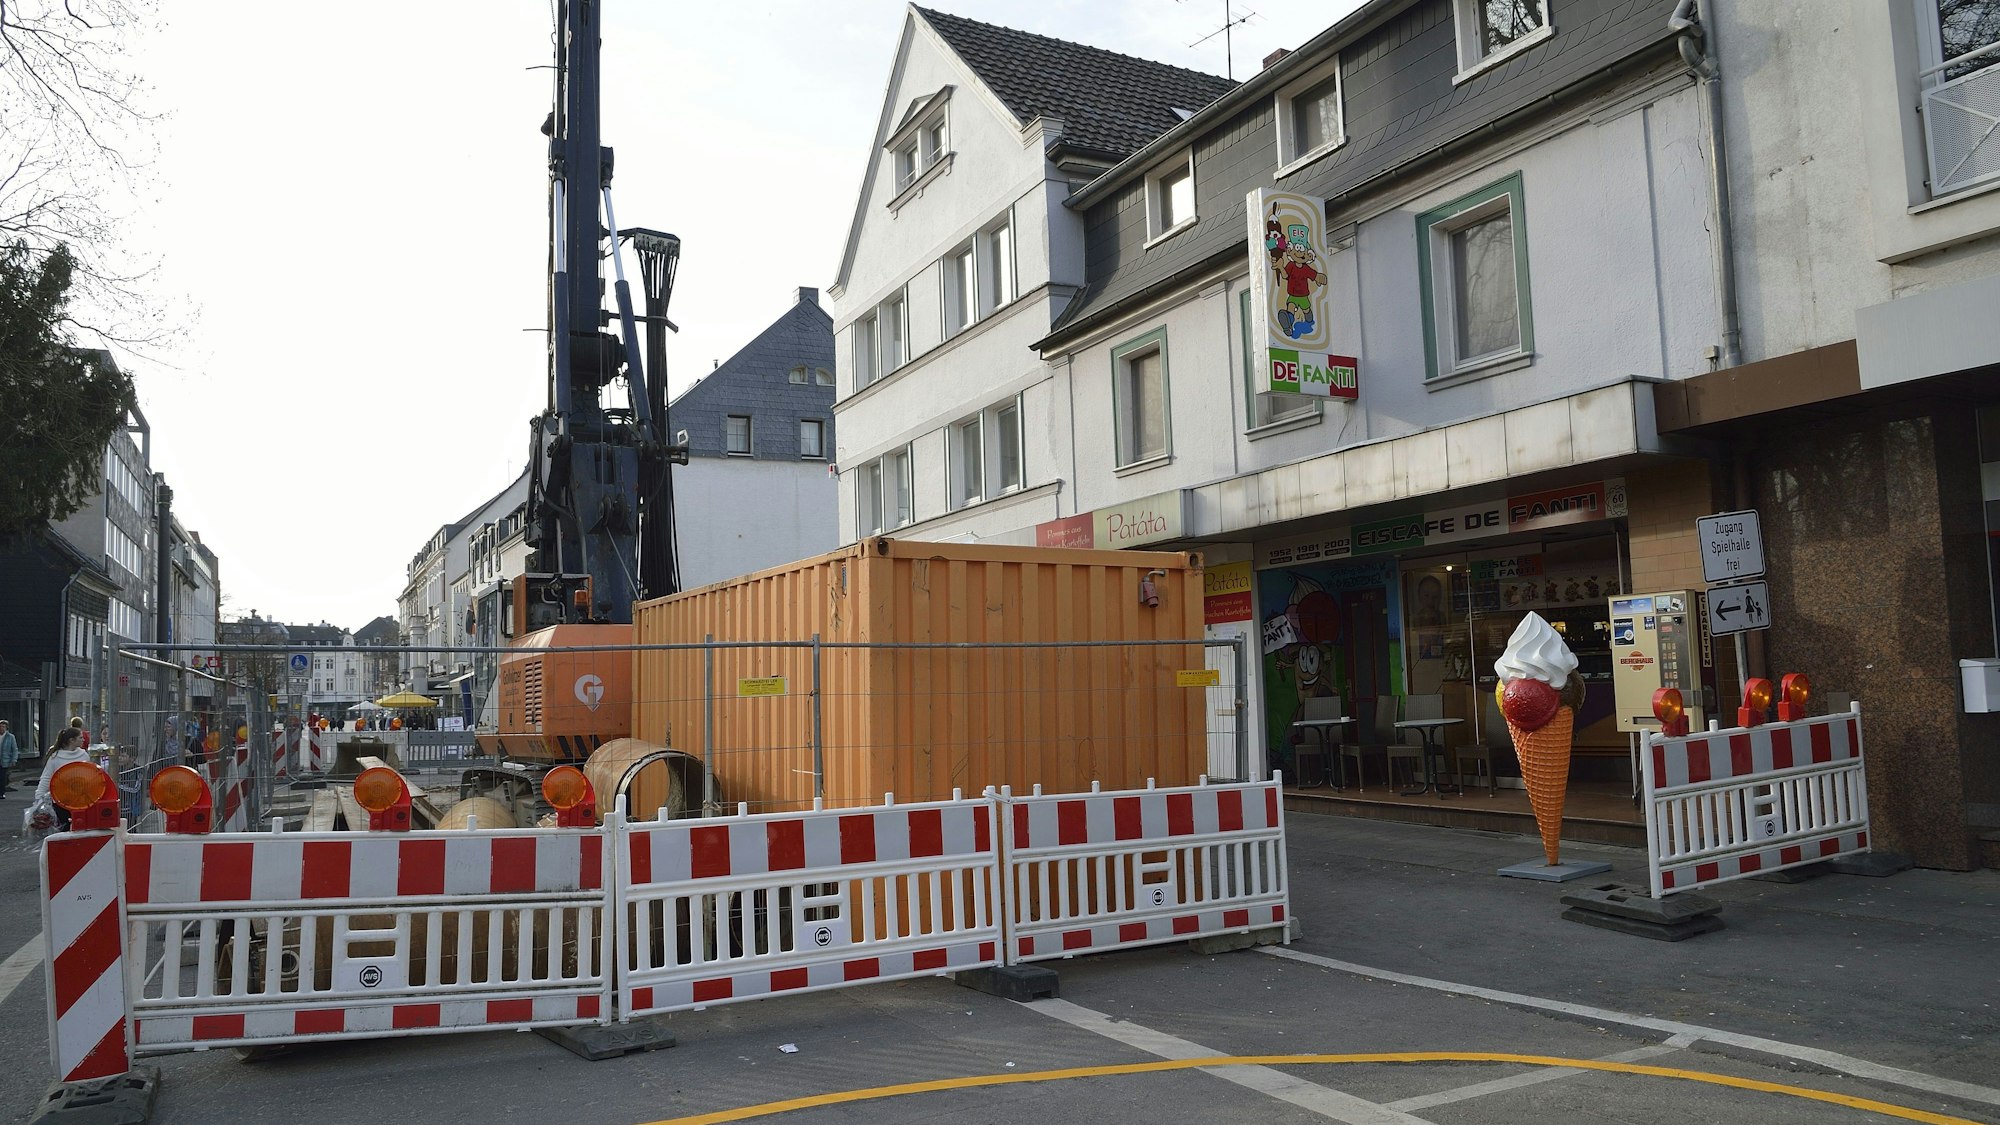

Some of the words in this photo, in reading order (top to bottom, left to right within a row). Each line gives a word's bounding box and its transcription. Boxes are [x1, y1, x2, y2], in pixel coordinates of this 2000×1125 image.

[1292, 228, 1305, 239] EIS
[1272, 359, 1299, 383] DE
[1302, 363, 1356, 390] FANTI
[1612, 493, 1624, 503] 60
[1106, 510, 1167, 542] Patáta
[1357, 518, 1455, 546] EISCAFE
[1464, 510, 1500, 530] DE
[1509, 492, 1598, 524] FANTI
[1715, 521, 1743, 537] Zugang
[1269, 548, 1292, 558] 1952
[1296, 543, 1320, 553] 1981
[1324, 538, 1350, 549] 2003
[1711, 538, 1751, 556] Spielhalle
[1726, 557, 1741, 571] frei
[1204, 571, 1249, 593] Patáta
[1479, 570, 1494, 579] DE
[1264, 620, 1276, 632] DE
[1700, 596, 1711, 666] CIGARETTEN
[1620, 657, 1654, 665] BERGHAUS
